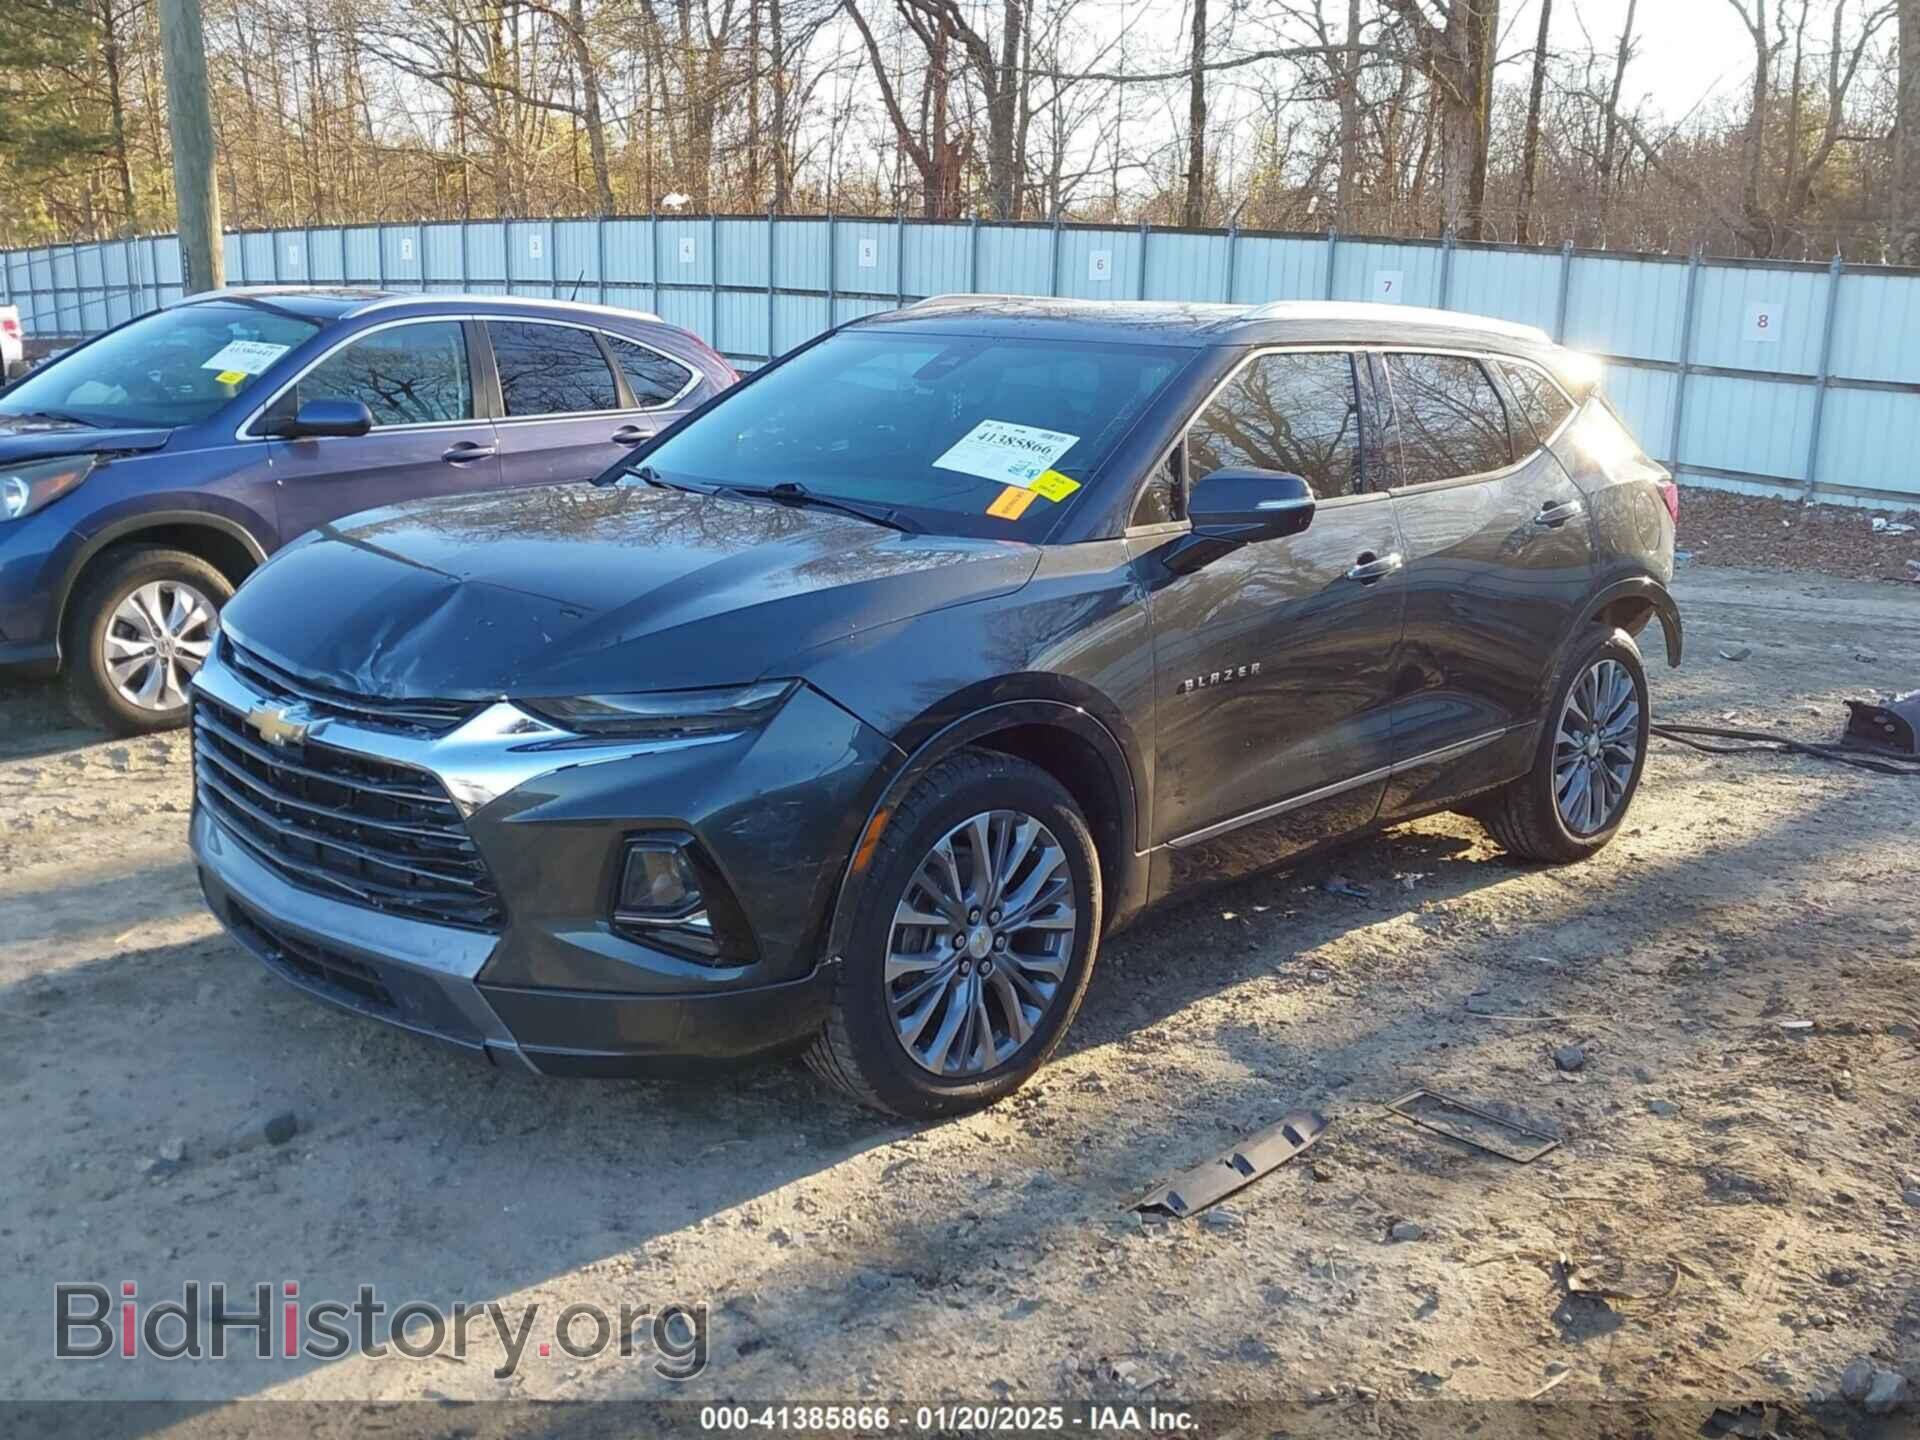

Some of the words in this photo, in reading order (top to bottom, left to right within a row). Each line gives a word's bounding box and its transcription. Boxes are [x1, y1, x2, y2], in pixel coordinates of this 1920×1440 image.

[865, 247, 871, 257] 5
[1096, 259, 1104, 270] 6
[1384, 281, 1392, 293] 7
[1757, 314, 1769, 328] 8
[977, 431, 1053, 454] 41385866
[1184, 662, 1261, 691] BLAZER
